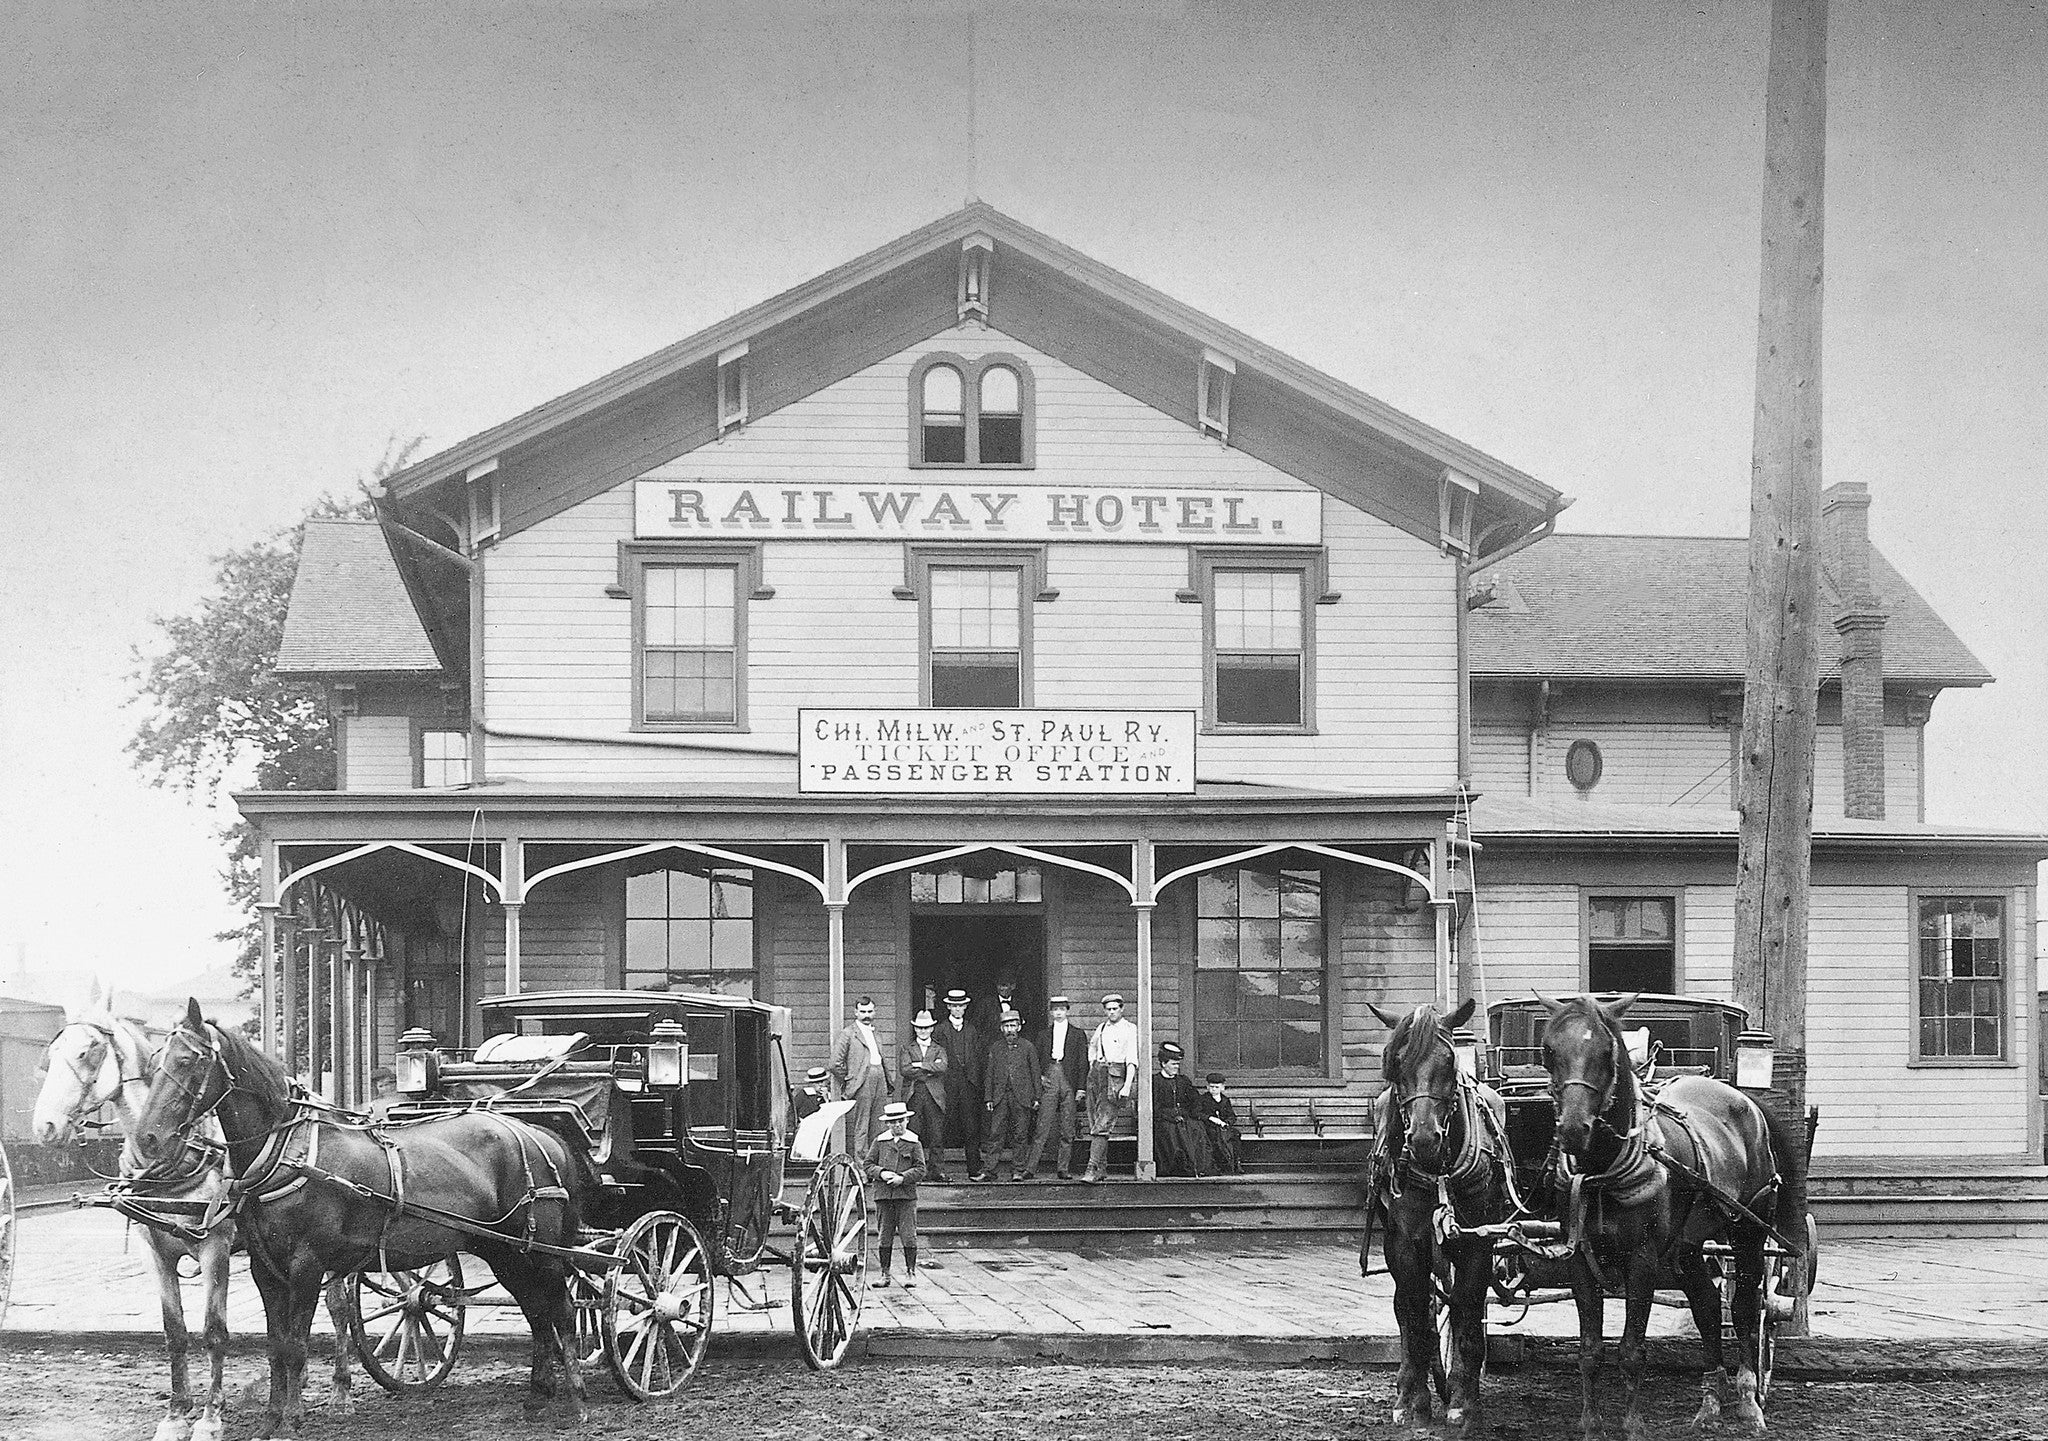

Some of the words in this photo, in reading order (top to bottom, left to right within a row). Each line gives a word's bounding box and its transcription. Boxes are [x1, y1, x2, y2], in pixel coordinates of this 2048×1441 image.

[668, 489, 1019, 531] RAILWAY
[1047, 493, 1287, 533] HOTEL.
[855, 744, 983, 762] TICKET
[1004, 744, 1129, 763] OFFICE
[821, 764, 1013, 781] PASSENGER
[1036, 764, 1183, 783] STATION.
